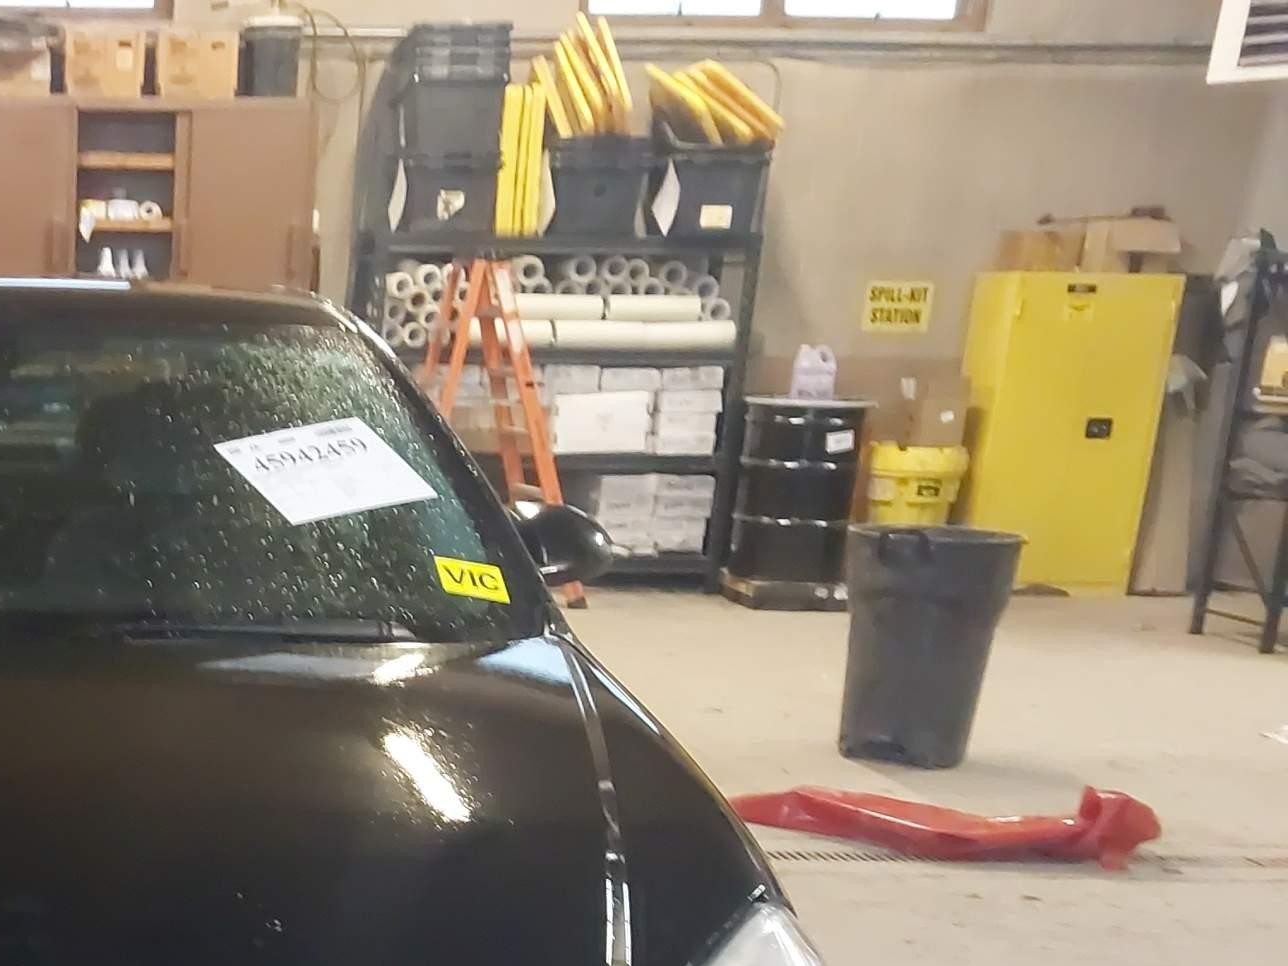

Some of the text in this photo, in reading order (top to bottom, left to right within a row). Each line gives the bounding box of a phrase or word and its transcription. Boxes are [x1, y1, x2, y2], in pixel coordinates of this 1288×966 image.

[869, 286, 929, 302] SPILL-KIT
[870, 307, 921, 324] STATION
[255, 437, 368, 471] 45942459
[441, 564, 499, 591] VIC
